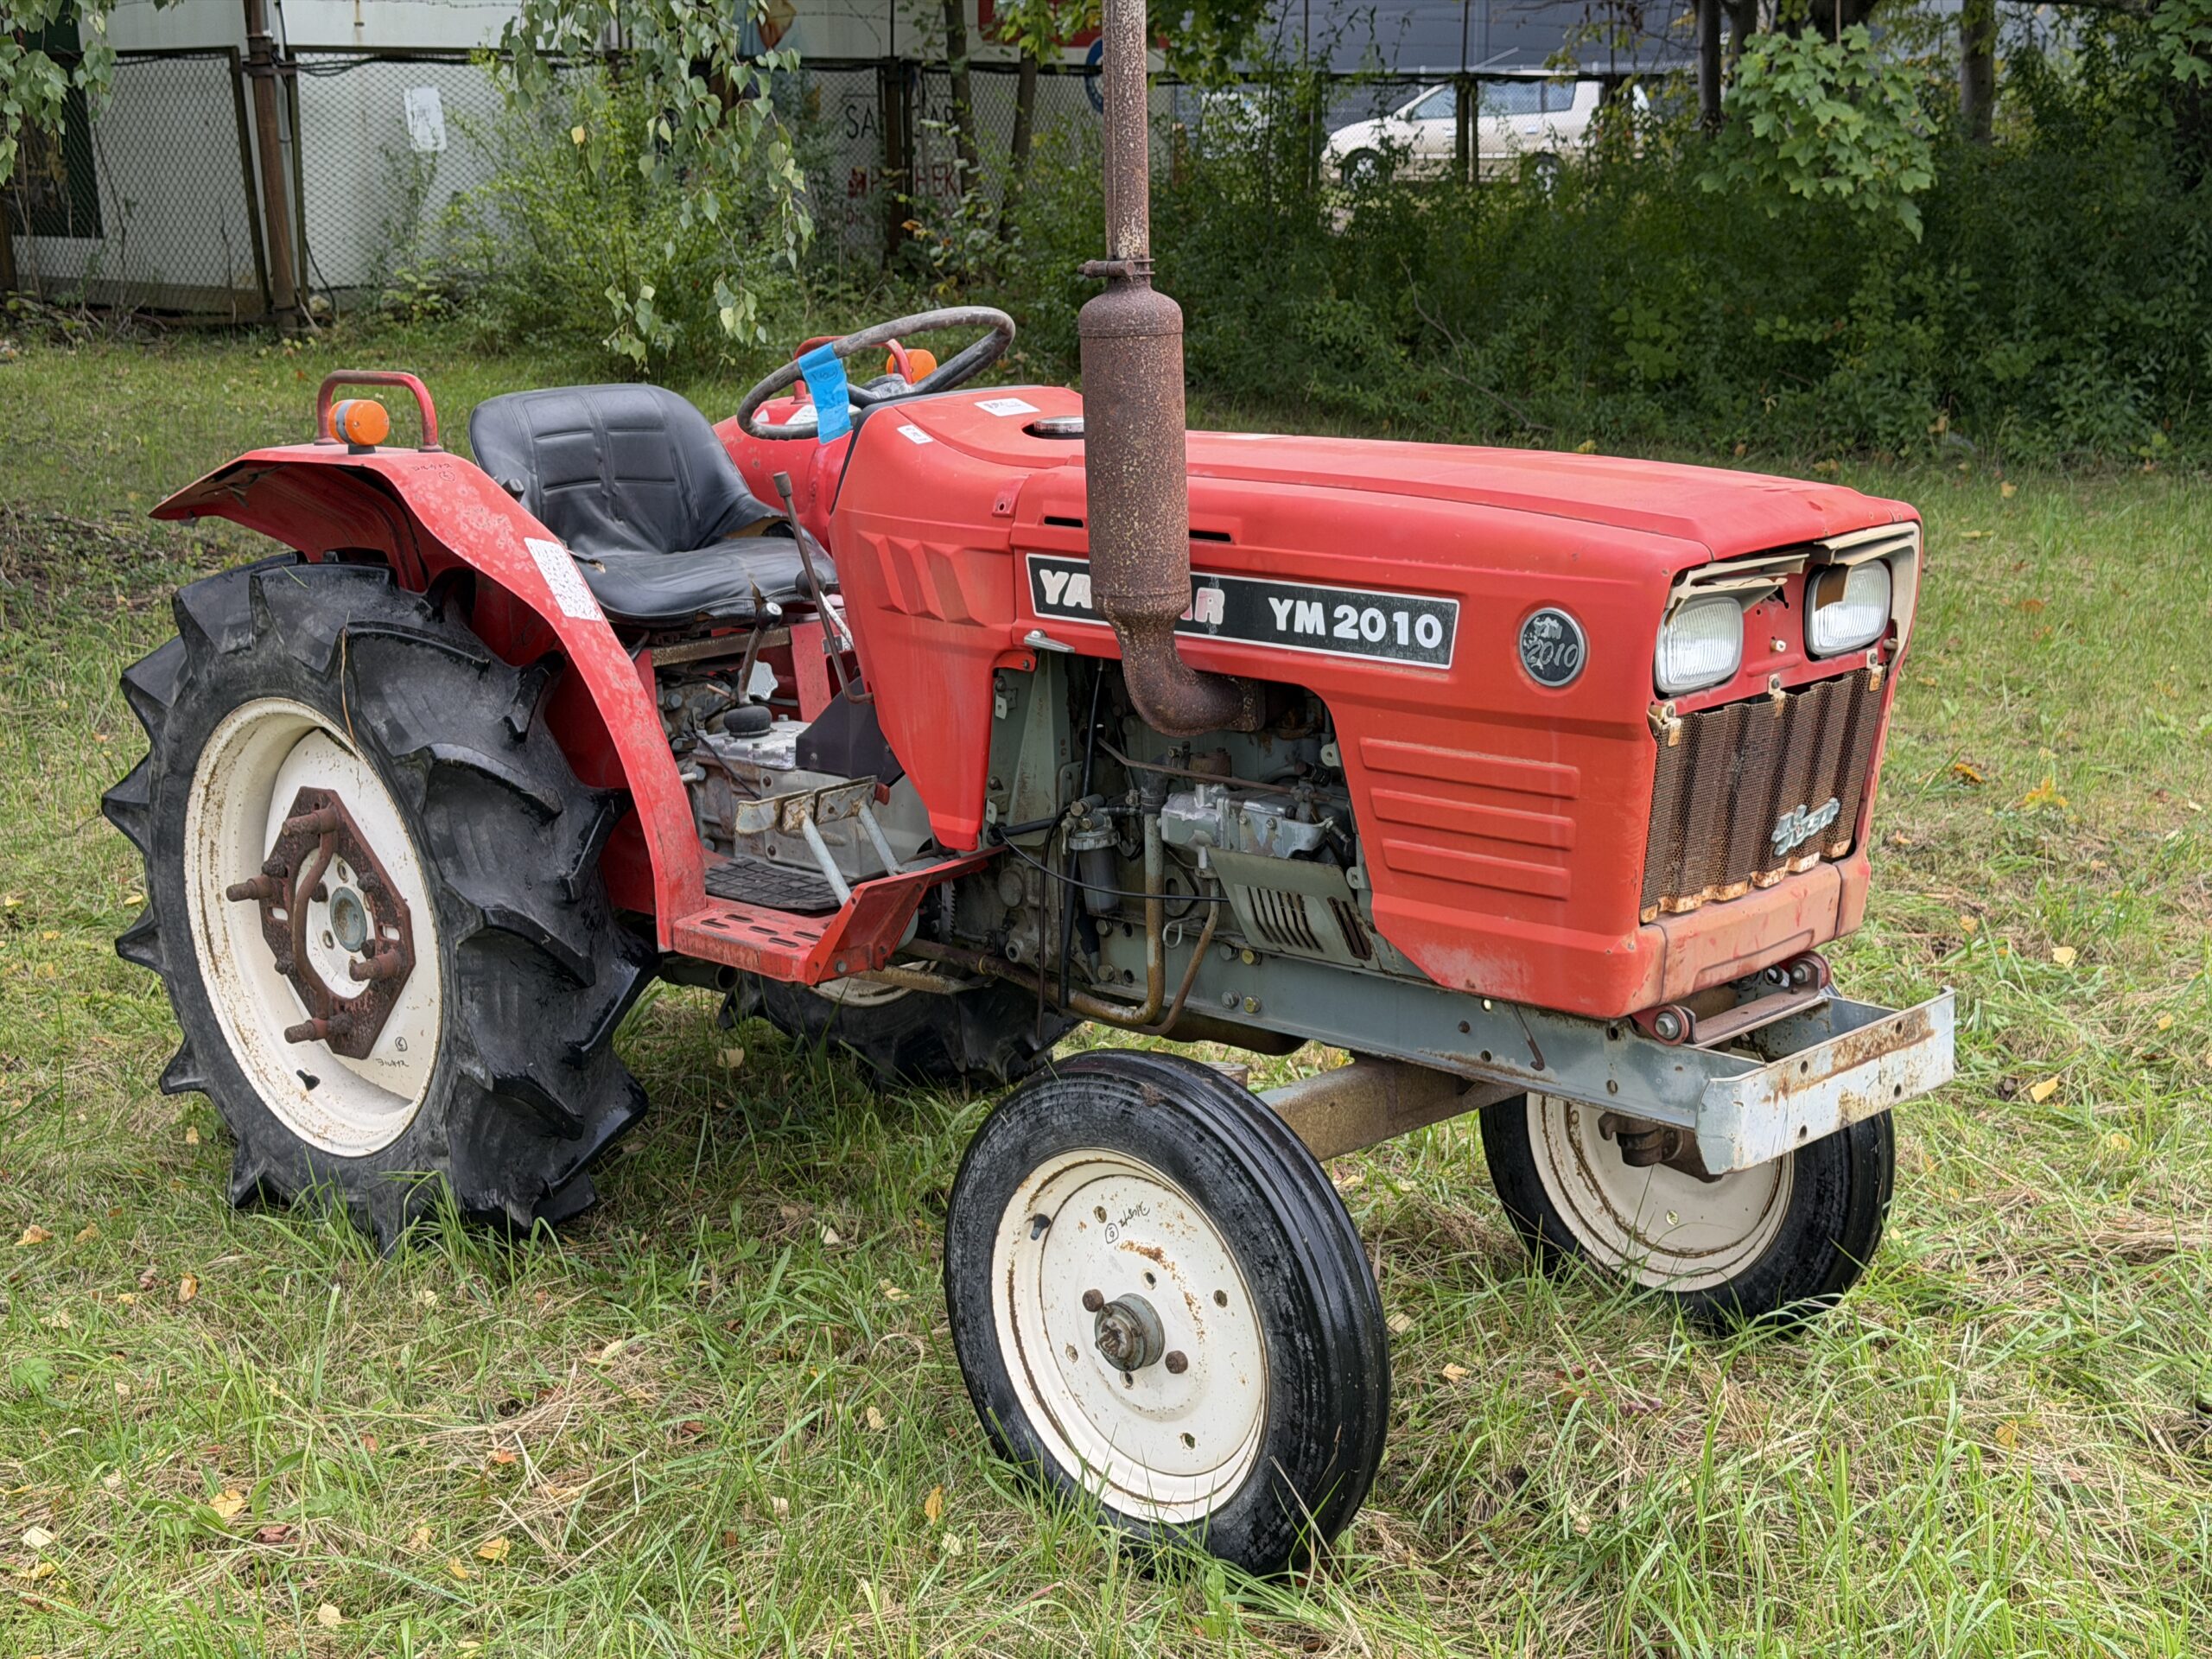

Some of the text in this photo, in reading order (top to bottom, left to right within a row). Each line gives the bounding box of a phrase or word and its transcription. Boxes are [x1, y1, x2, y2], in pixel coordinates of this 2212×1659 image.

[1039, 569, 1443, 649] YAR YM 2010
[1527, 639, 1579, 668] 2010
